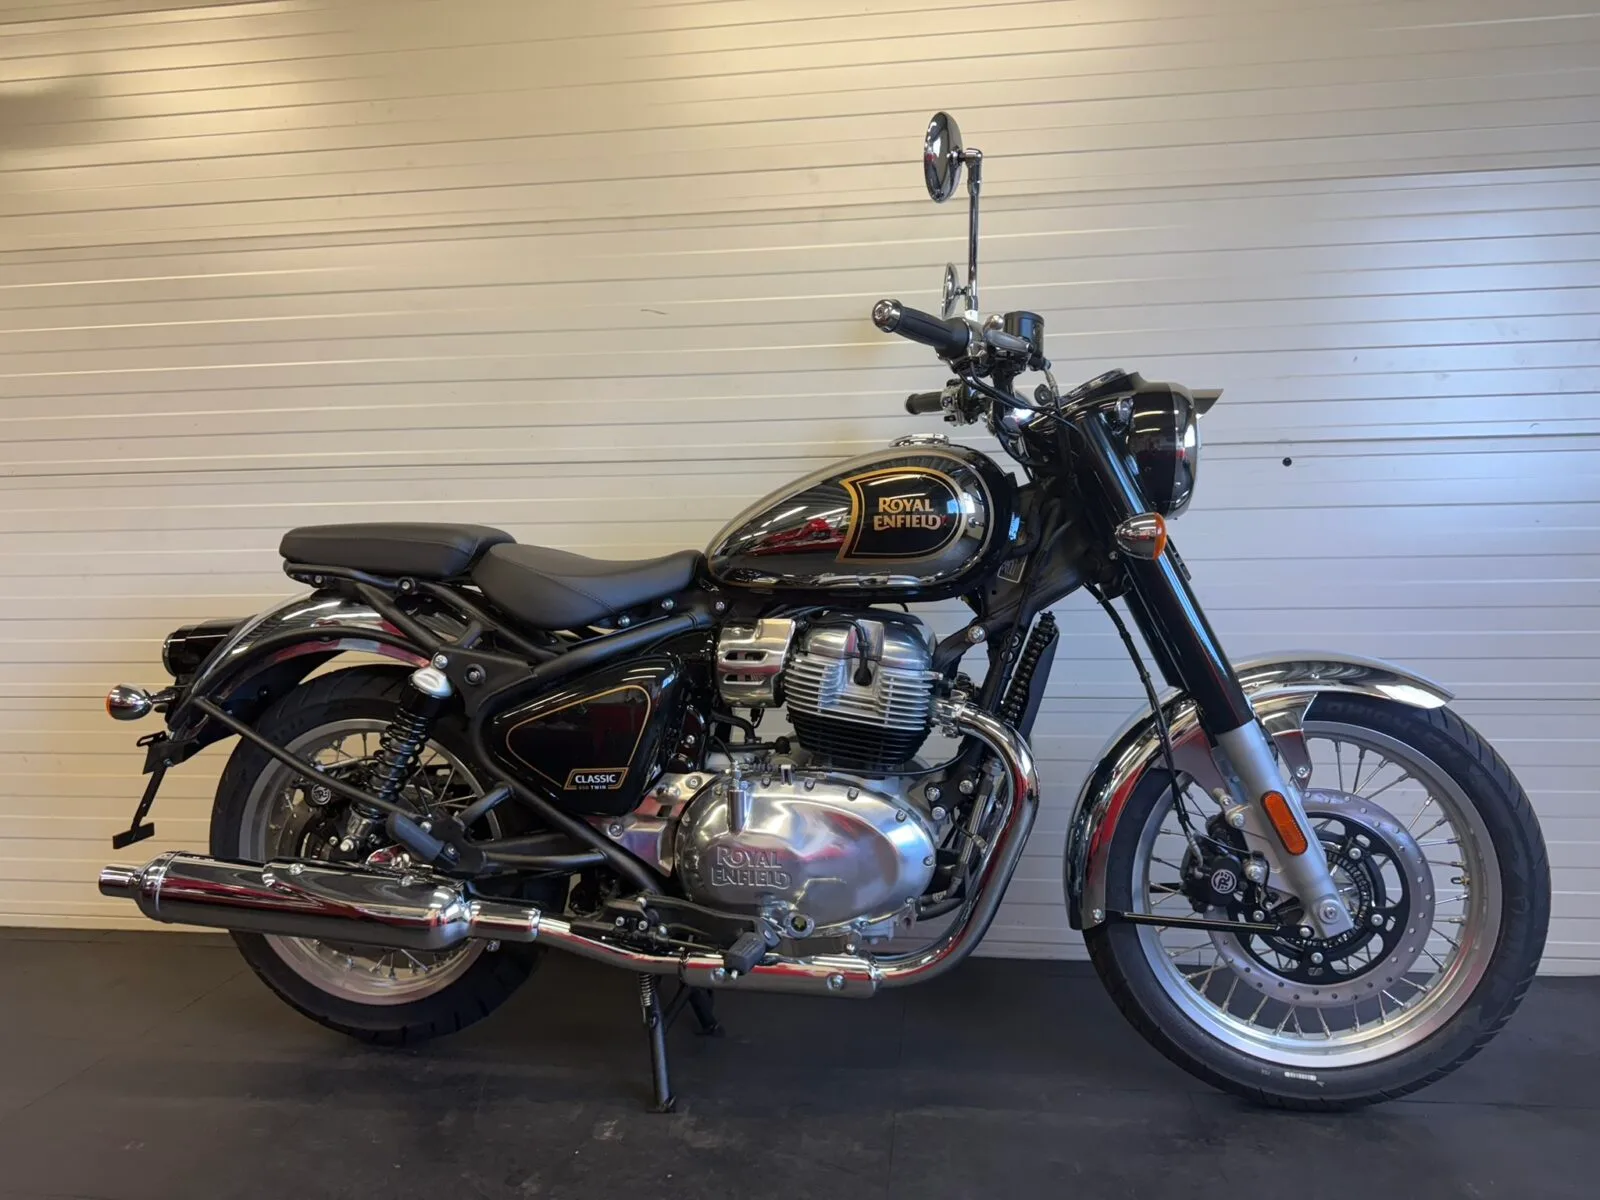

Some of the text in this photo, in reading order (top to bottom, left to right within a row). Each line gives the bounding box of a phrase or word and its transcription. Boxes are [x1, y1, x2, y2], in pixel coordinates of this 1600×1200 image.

[878, 497, 934, 513] ROYAL
[873, 515, 941, 531] ENFIELD
[575, 774, 616, 783] CLASSIC
[717, 846, 782, 868] ROYAL
[711, 867, 793, 890] ENFIELD
